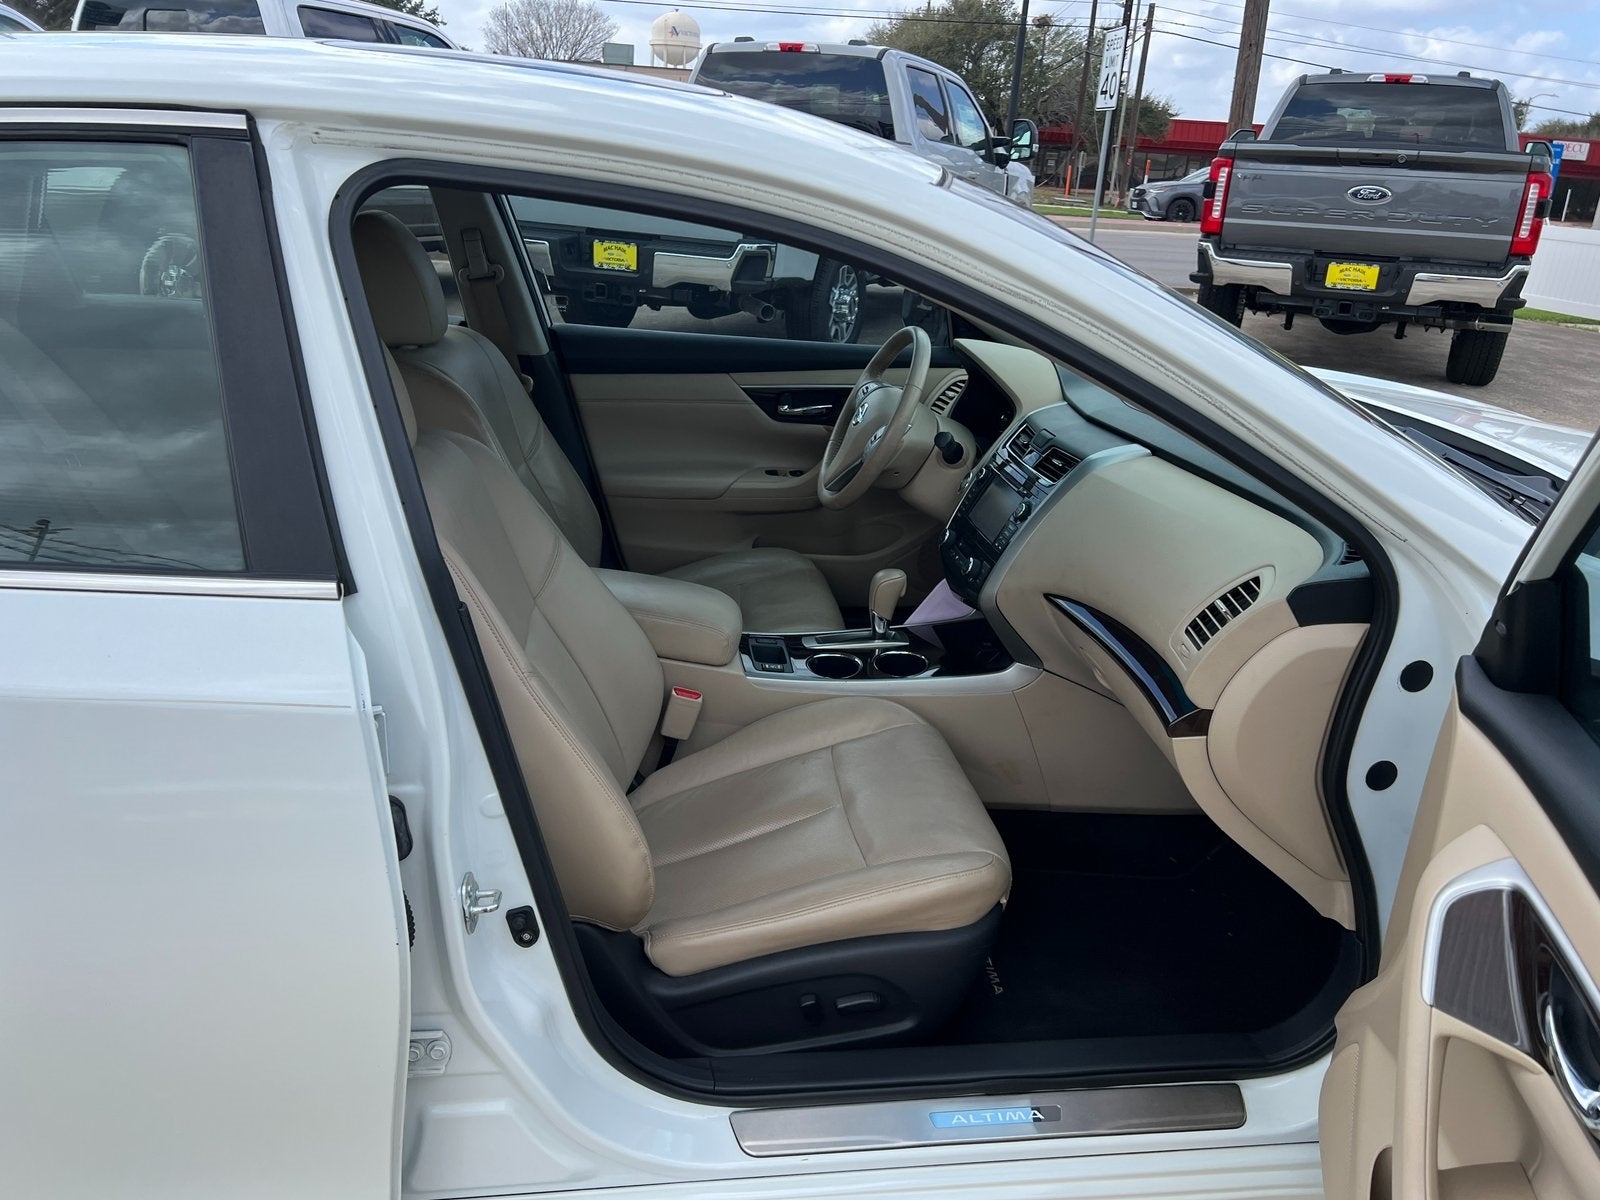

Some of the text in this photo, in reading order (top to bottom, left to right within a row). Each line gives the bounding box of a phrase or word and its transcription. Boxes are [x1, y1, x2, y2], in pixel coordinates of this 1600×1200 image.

[1105, 36, 1124, 52] SPEED
[1104, 54, 1120, 69] LIMIT
[1100, 72, 1118, 100] 40
[1356, 188, 1382, 200] Ford
[1241, 204, 1499, 228] SUPER DUTY
[985, 956, 1004, 995] TIMA
[951, 1110, 1045, 1125] ALTIMA
